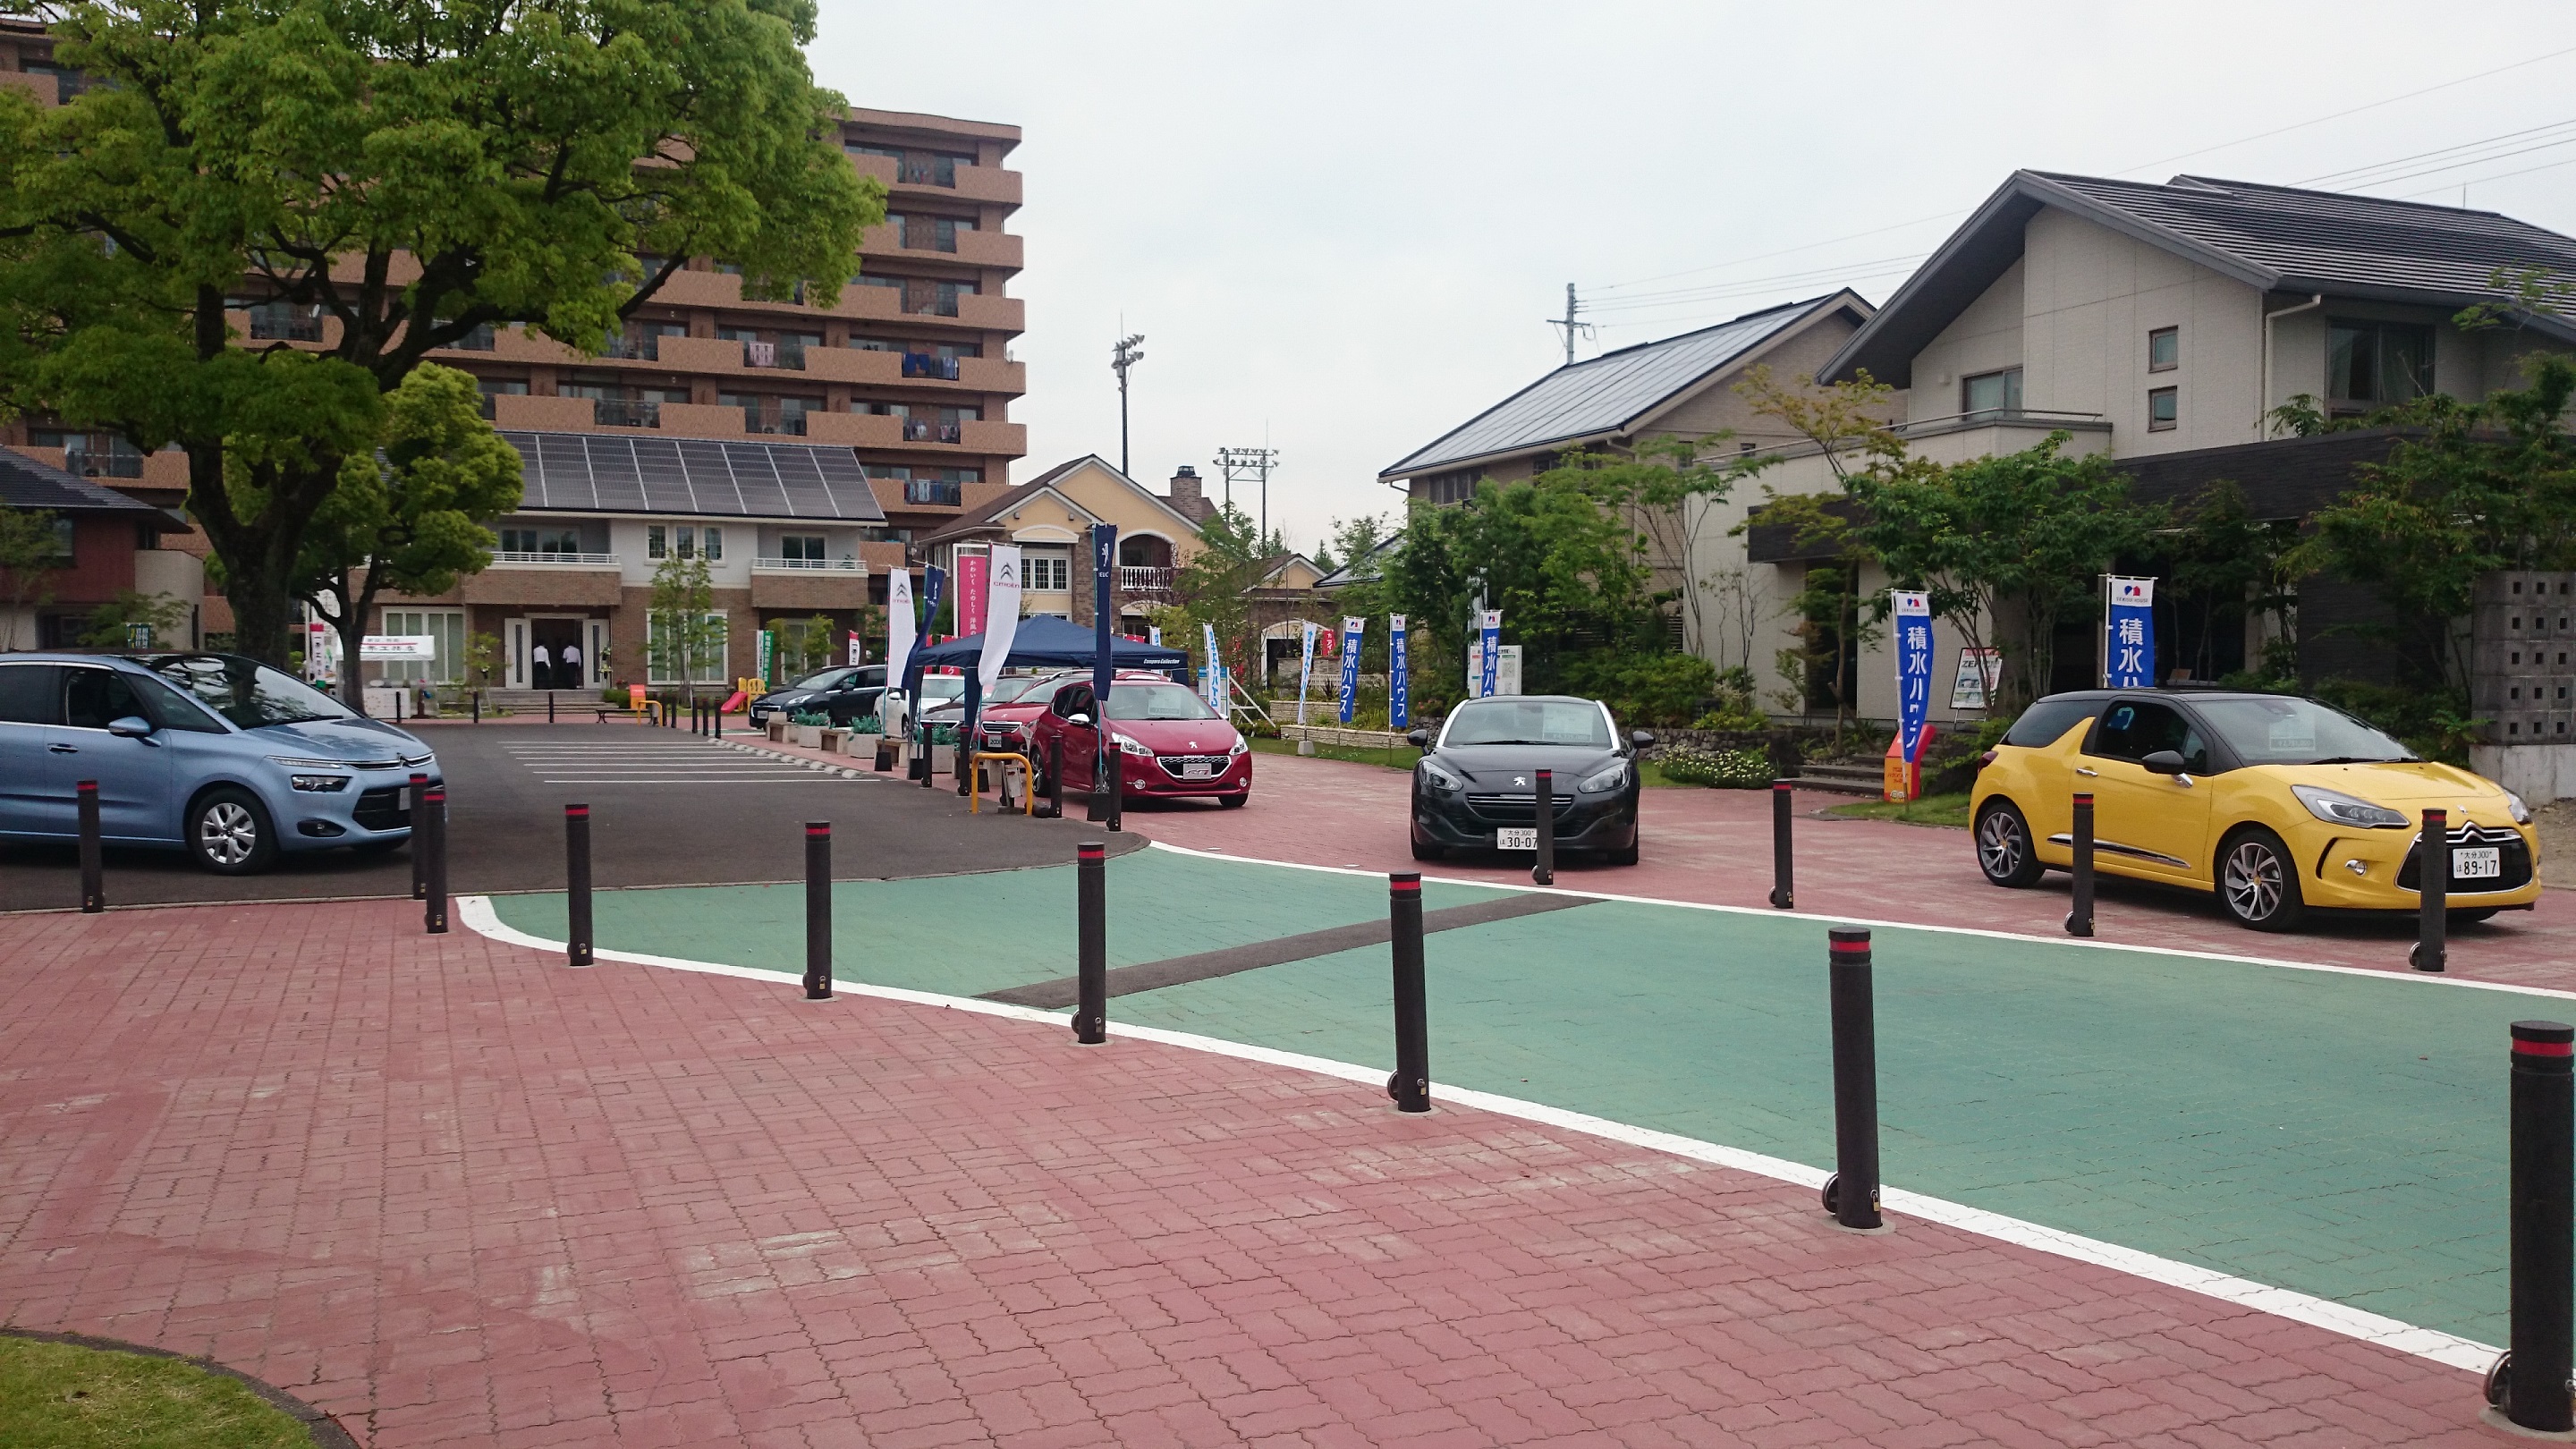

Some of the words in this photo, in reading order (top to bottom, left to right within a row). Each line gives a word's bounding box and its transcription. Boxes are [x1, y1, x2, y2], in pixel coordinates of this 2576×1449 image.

[1340, 639, 1358, 714] 積水ハウス
[1396, 638, 1405, 718] 積水ハウス
[2463, 860, 2497, 876] 89-17
